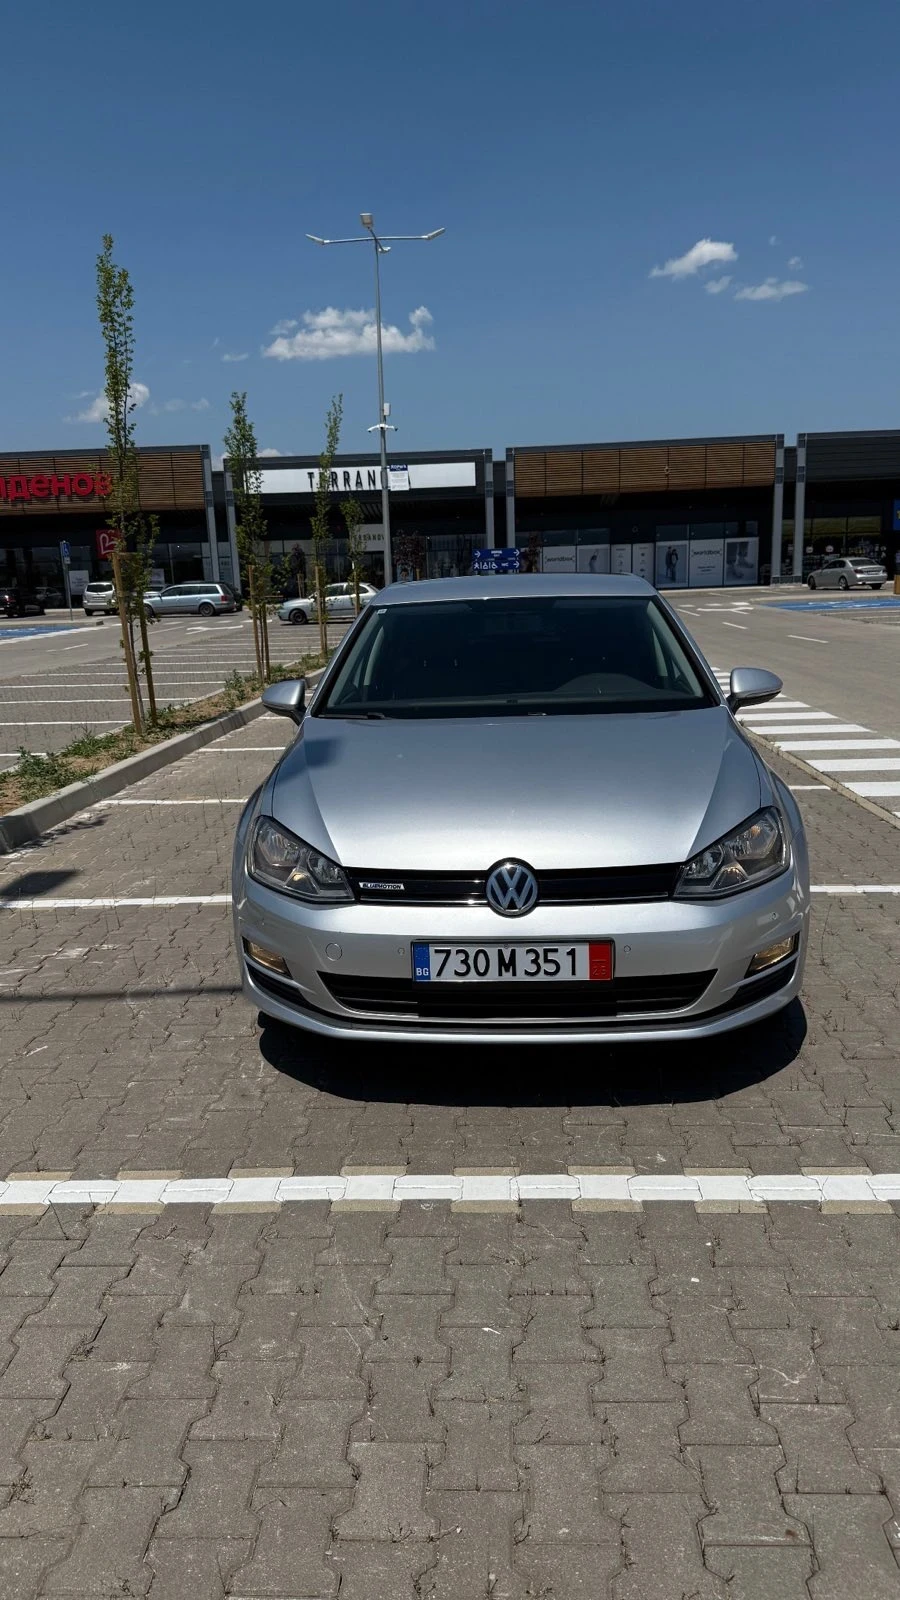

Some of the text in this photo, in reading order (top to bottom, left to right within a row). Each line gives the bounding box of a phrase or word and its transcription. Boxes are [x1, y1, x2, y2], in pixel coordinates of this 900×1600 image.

[416, 967, 429, 977] BG
[434, 948, 577, 977] 730 M 351
